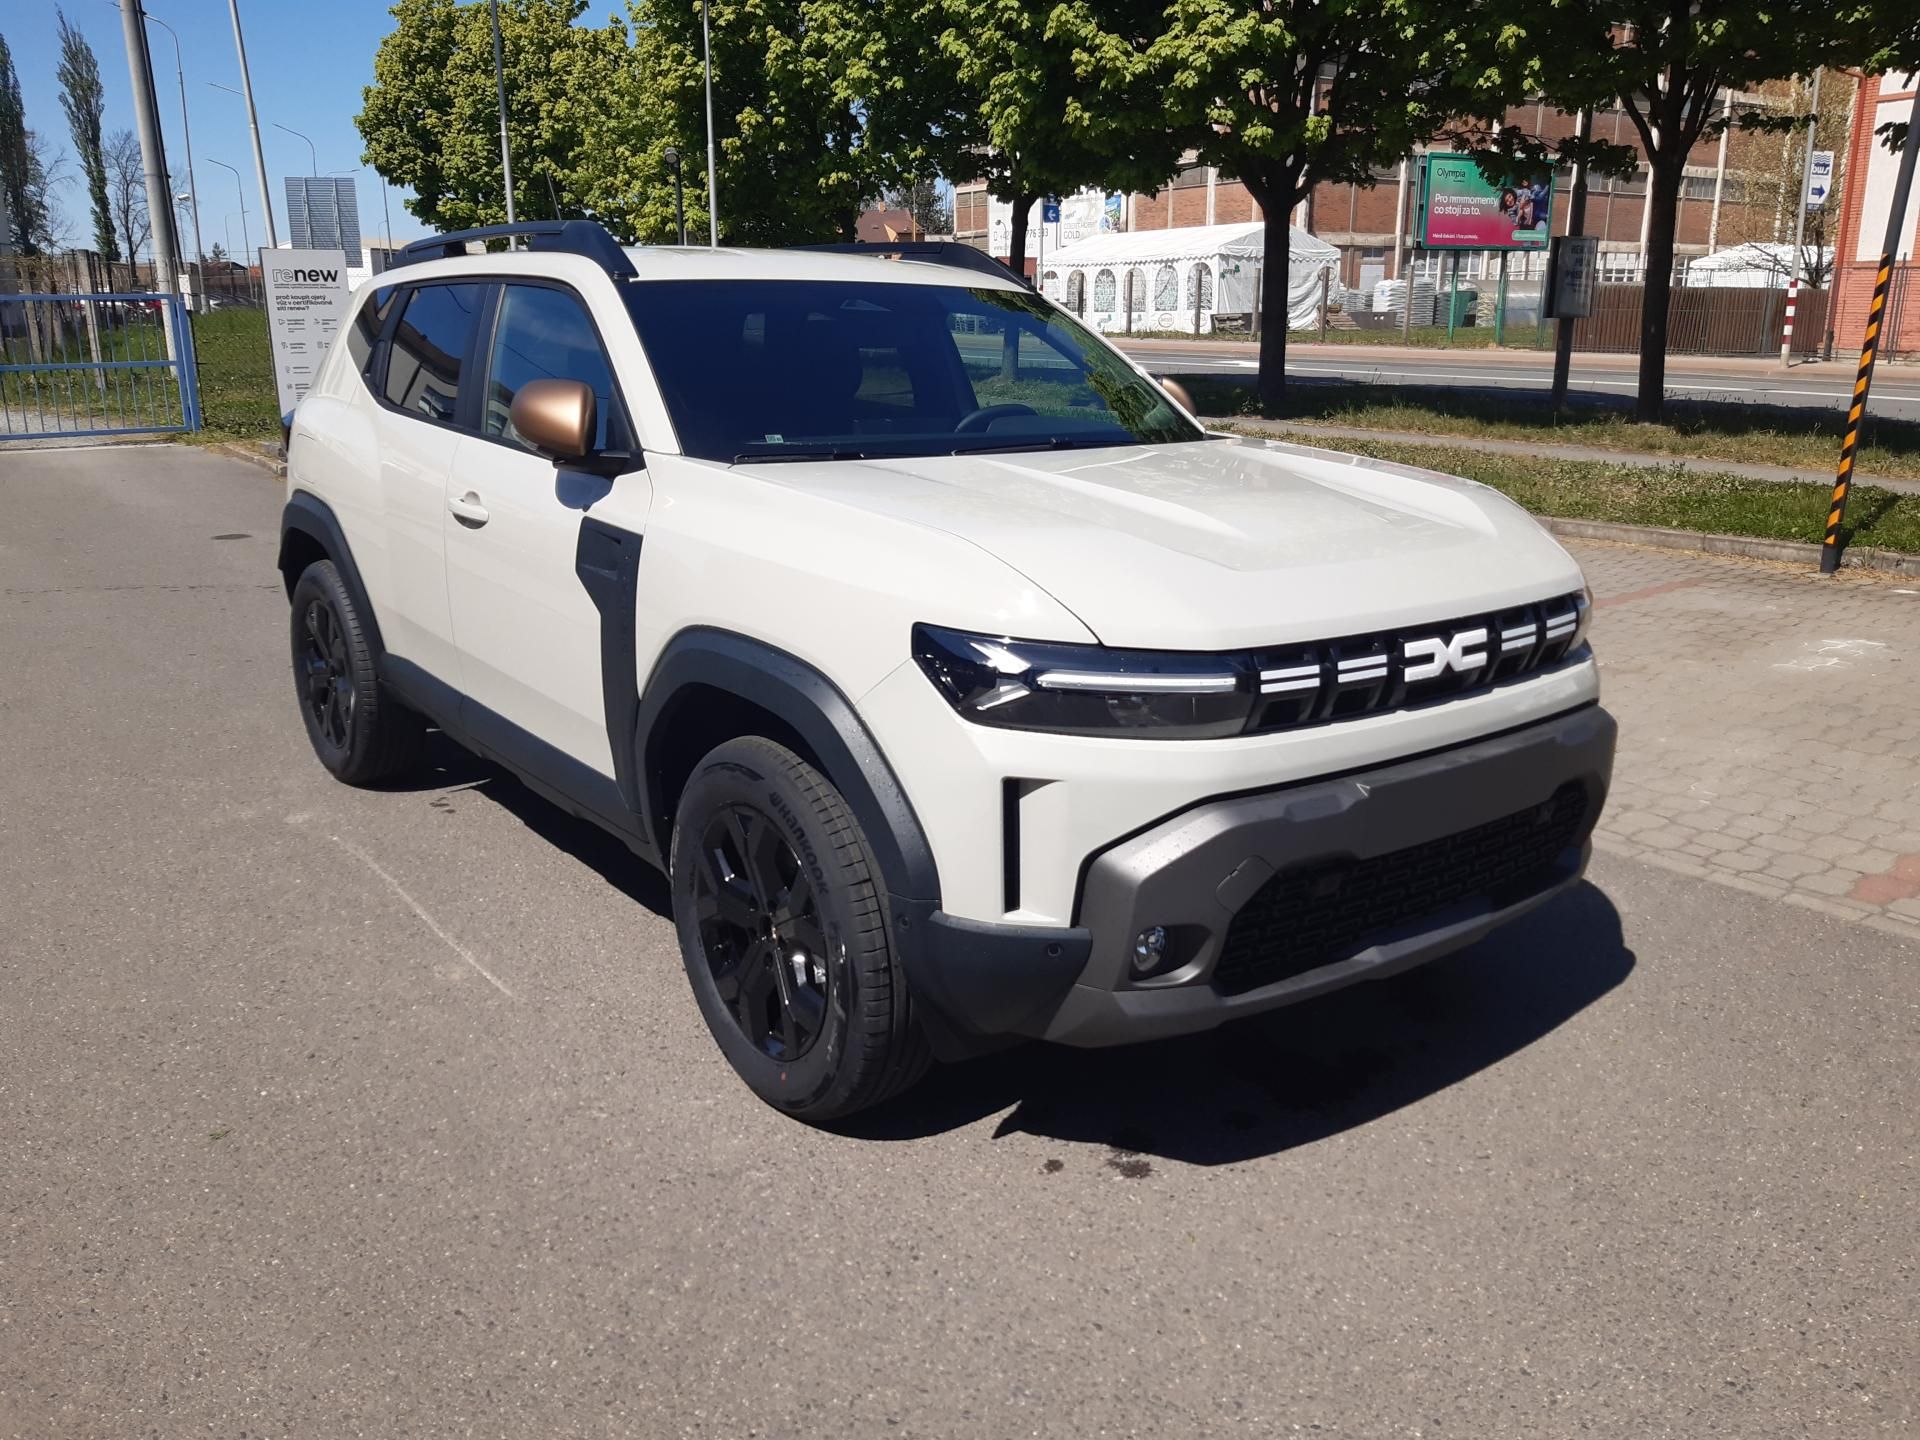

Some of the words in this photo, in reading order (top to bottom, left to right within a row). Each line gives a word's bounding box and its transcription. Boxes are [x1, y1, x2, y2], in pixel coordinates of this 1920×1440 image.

[1437, 167, 1466, 179] Olympia
[1435, 193, 1448, 203] Pro
[1434, 206, 1444, 214] co
[1462, 207, 1470, 215] za
[1471, 206, 1481, 215] to.
[272, 268, 338, 283] renew
